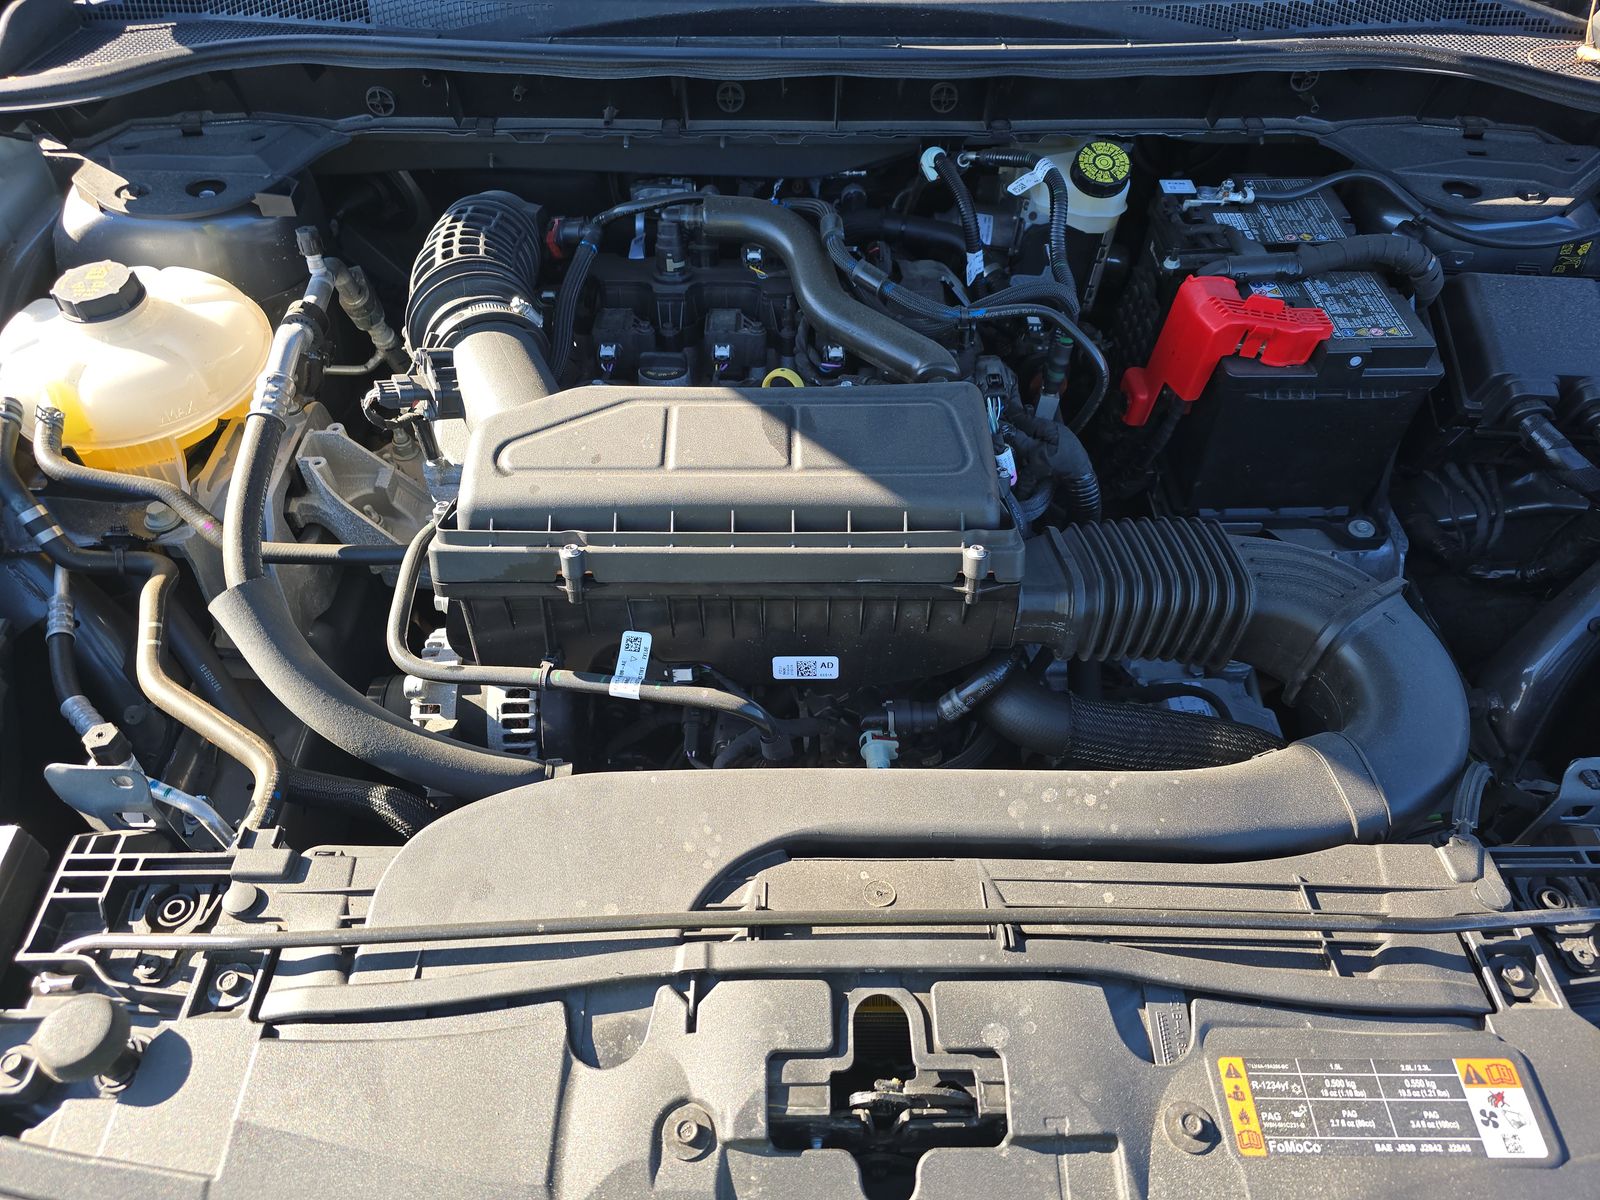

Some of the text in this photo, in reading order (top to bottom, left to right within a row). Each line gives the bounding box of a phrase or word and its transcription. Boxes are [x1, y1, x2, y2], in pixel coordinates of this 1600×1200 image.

[1251, 1080, 1289, 1092] R-1234yf
[1325, 1079, 1357, 1090] 0.500 kg
[1404, 1079, 1437, 1090] 0.550 kg
[1261, 1111, 1281, 1121] PAG
[1341, 1109, 1358, 1118] PAG
[1423, 1110, 1439, 1119] PAG
[1268, 1140, 1322, 1153] FoMoCo
